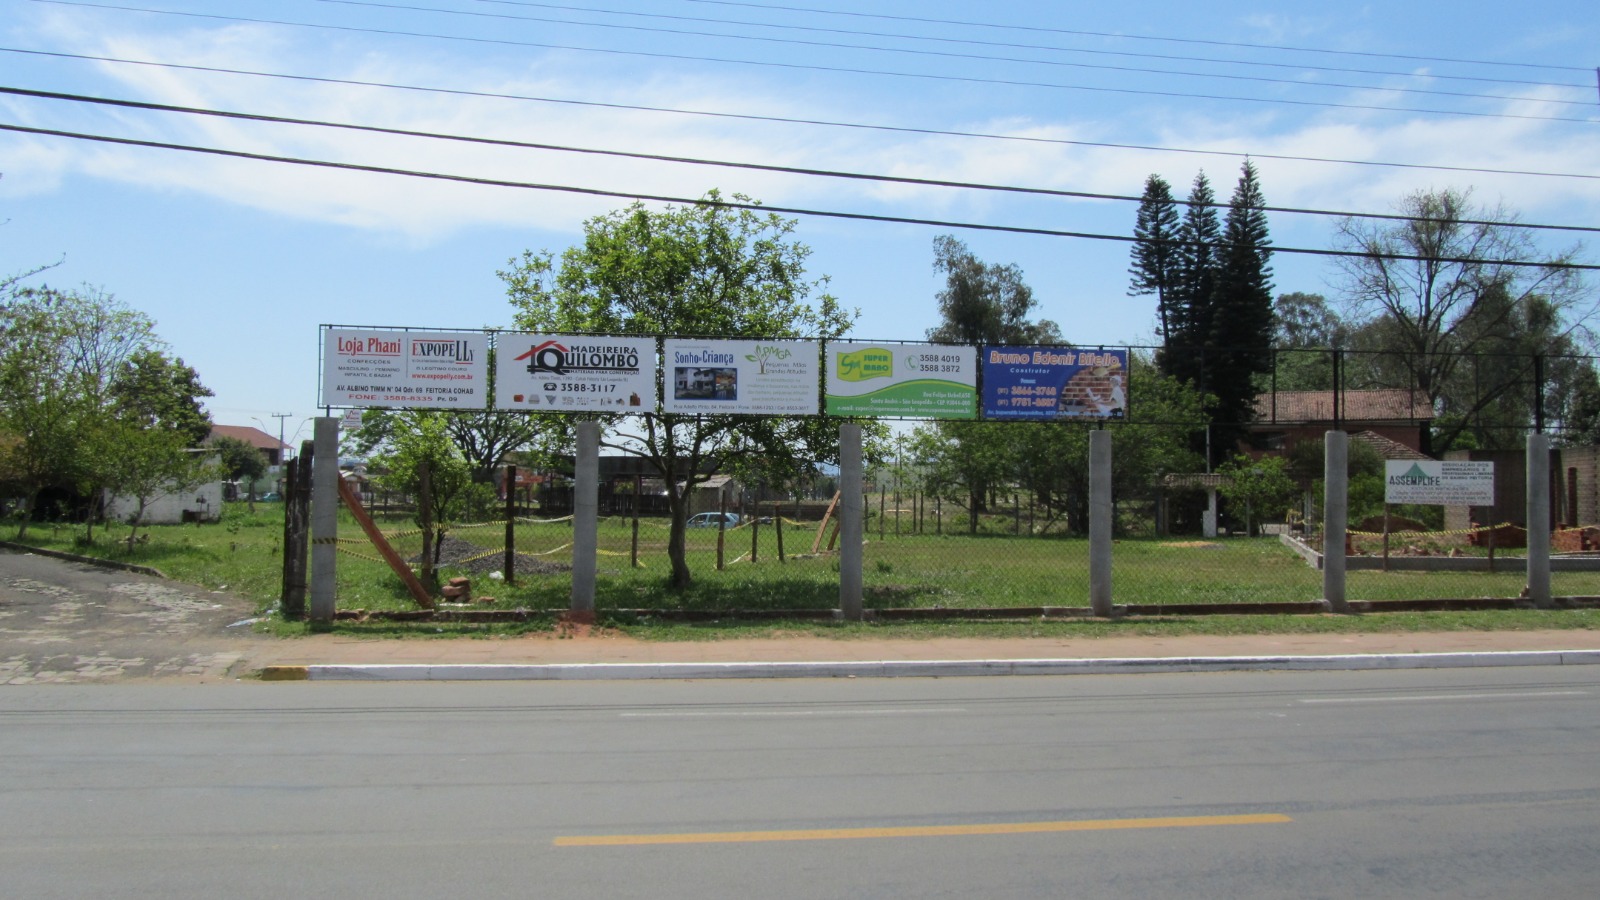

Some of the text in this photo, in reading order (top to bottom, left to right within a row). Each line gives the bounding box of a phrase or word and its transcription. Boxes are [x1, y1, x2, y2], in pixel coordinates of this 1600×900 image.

[338, 337, 401, 356] Loja Phani
[570, 346, 638, 354] MADEIREIRA
[537, 348, 638, 375] QUILOMBO
[675, 351, 699, 364] Sonho
[703, 350, 734, 366] Criança
[920, 354, 960, 363] 3588 4019
[990, 350, 1029, 365] Bruno
[1032, 351, 1076, 365] Edenir
[920, 364, 939, 372] 3588
[561, 383, 616, 392] 3588-3117
[1390, 475, 1440, 486] ASSEMPLIFE
